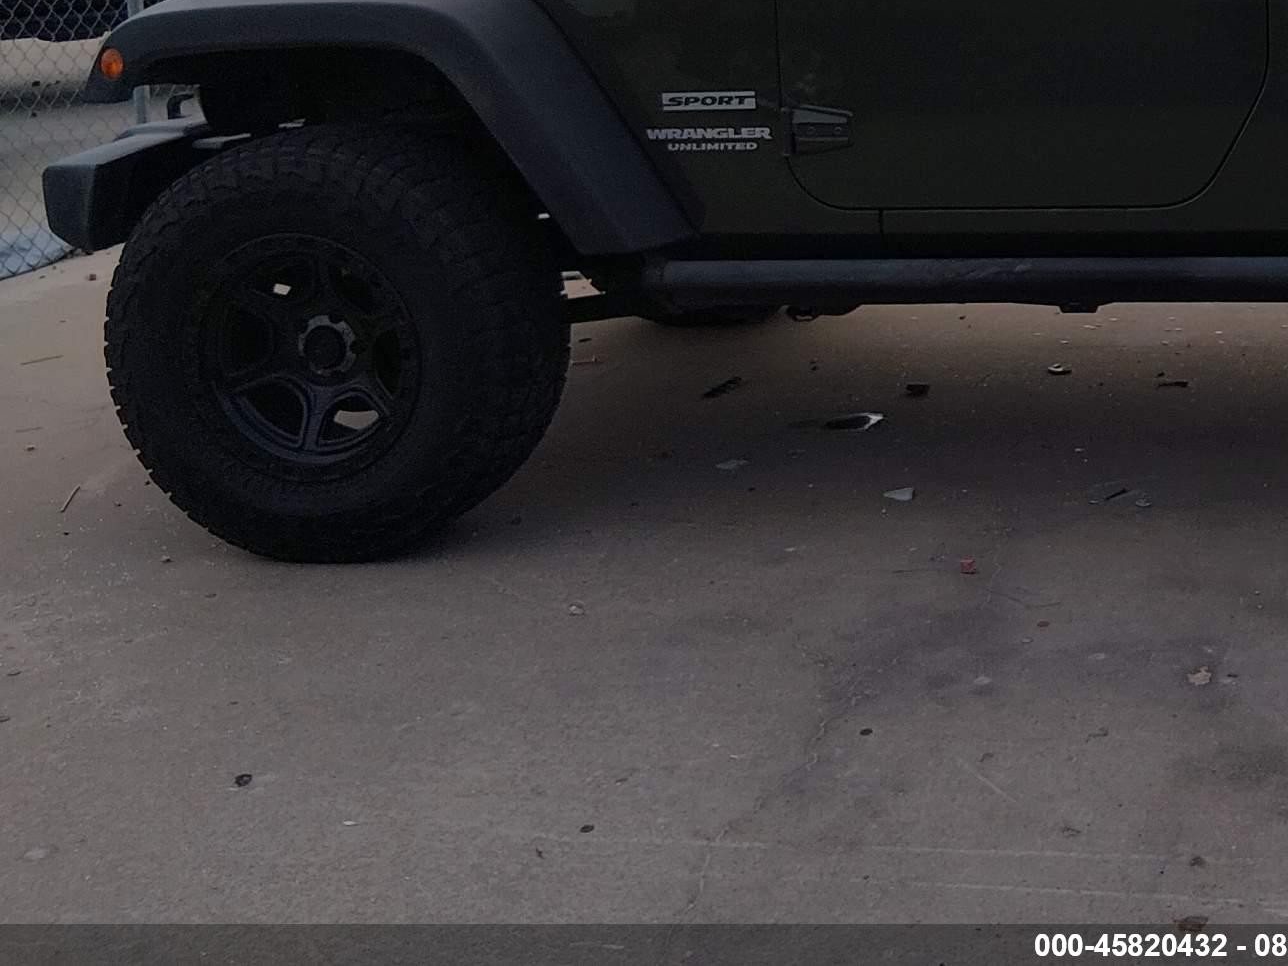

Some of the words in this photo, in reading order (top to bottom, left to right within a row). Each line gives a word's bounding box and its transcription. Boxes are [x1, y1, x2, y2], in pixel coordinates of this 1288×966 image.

[663, 94, 754, 108] SPORT
[646, 127, 772, 140] WRANGLER
[667, 142, 758, 151] UNLIMITED
